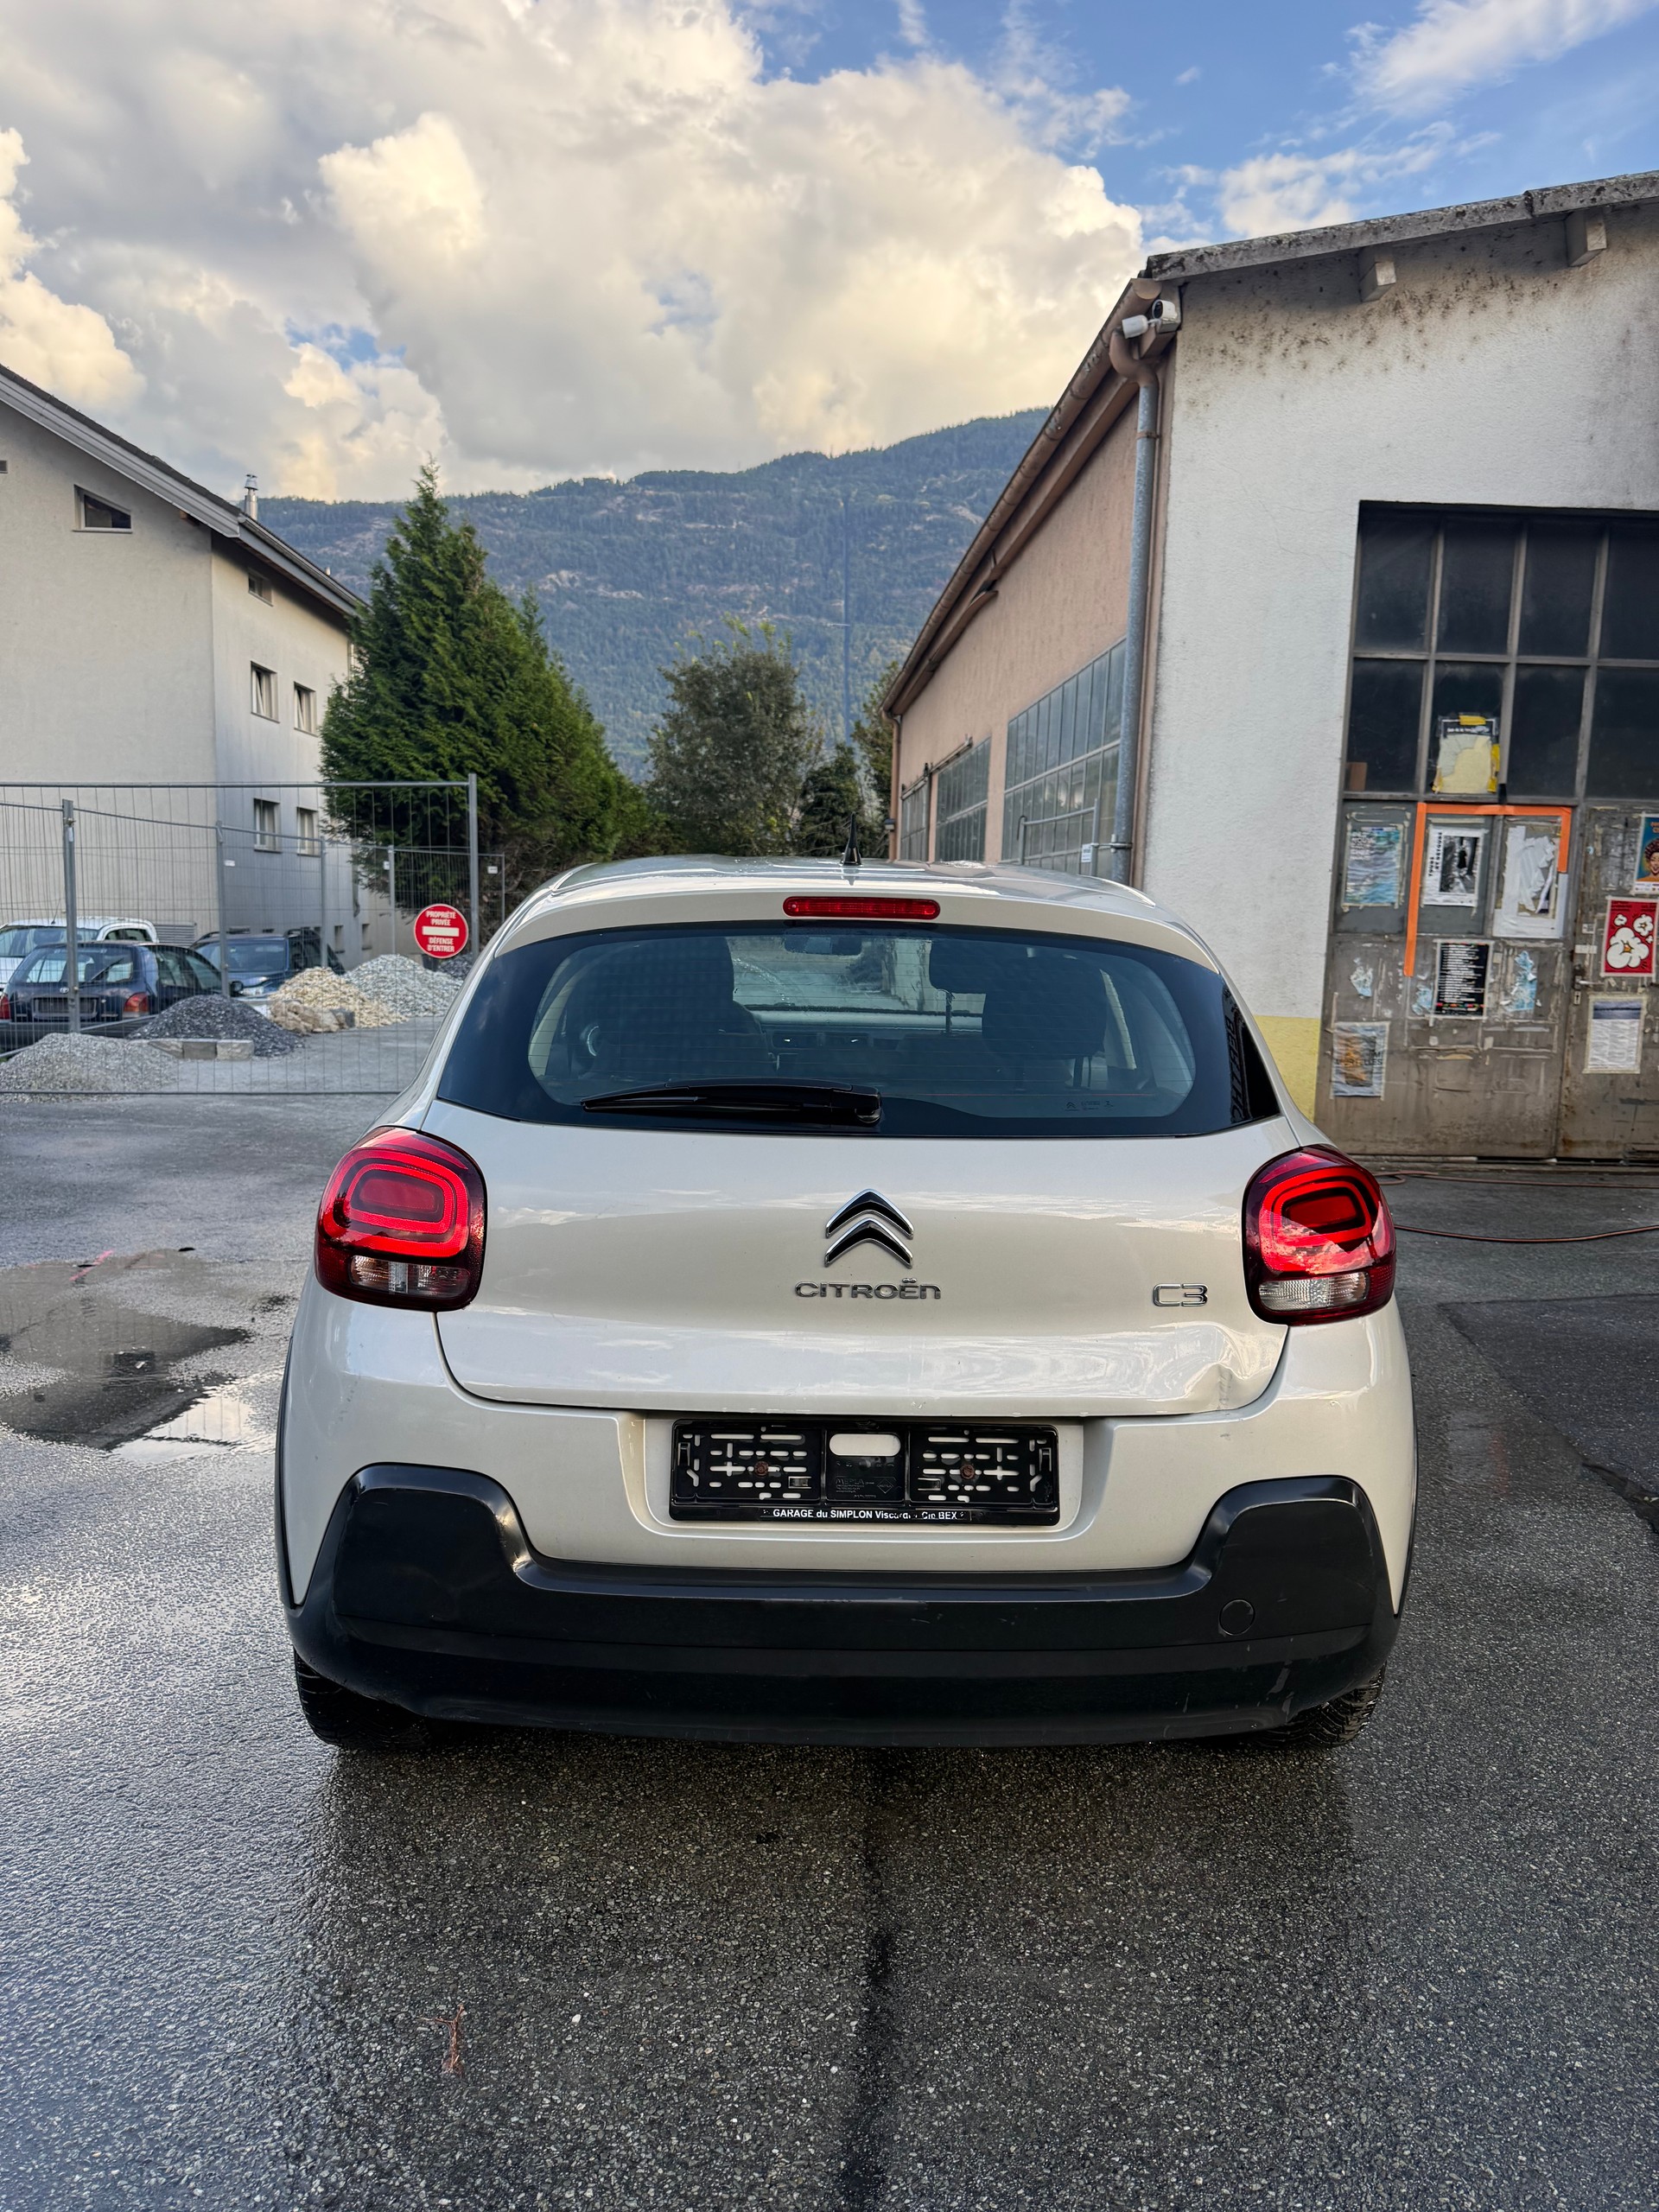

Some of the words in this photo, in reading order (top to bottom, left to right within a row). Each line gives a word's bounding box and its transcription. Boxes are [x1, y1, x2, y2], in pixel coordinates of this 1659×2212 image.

[1152, 1282, 1208, 1306] C3
[772, 1509, 814, 1517] GARAGE
[817, 1510, 828, 1518] du
[830, 1510, 873, 1518] SIMPLON
